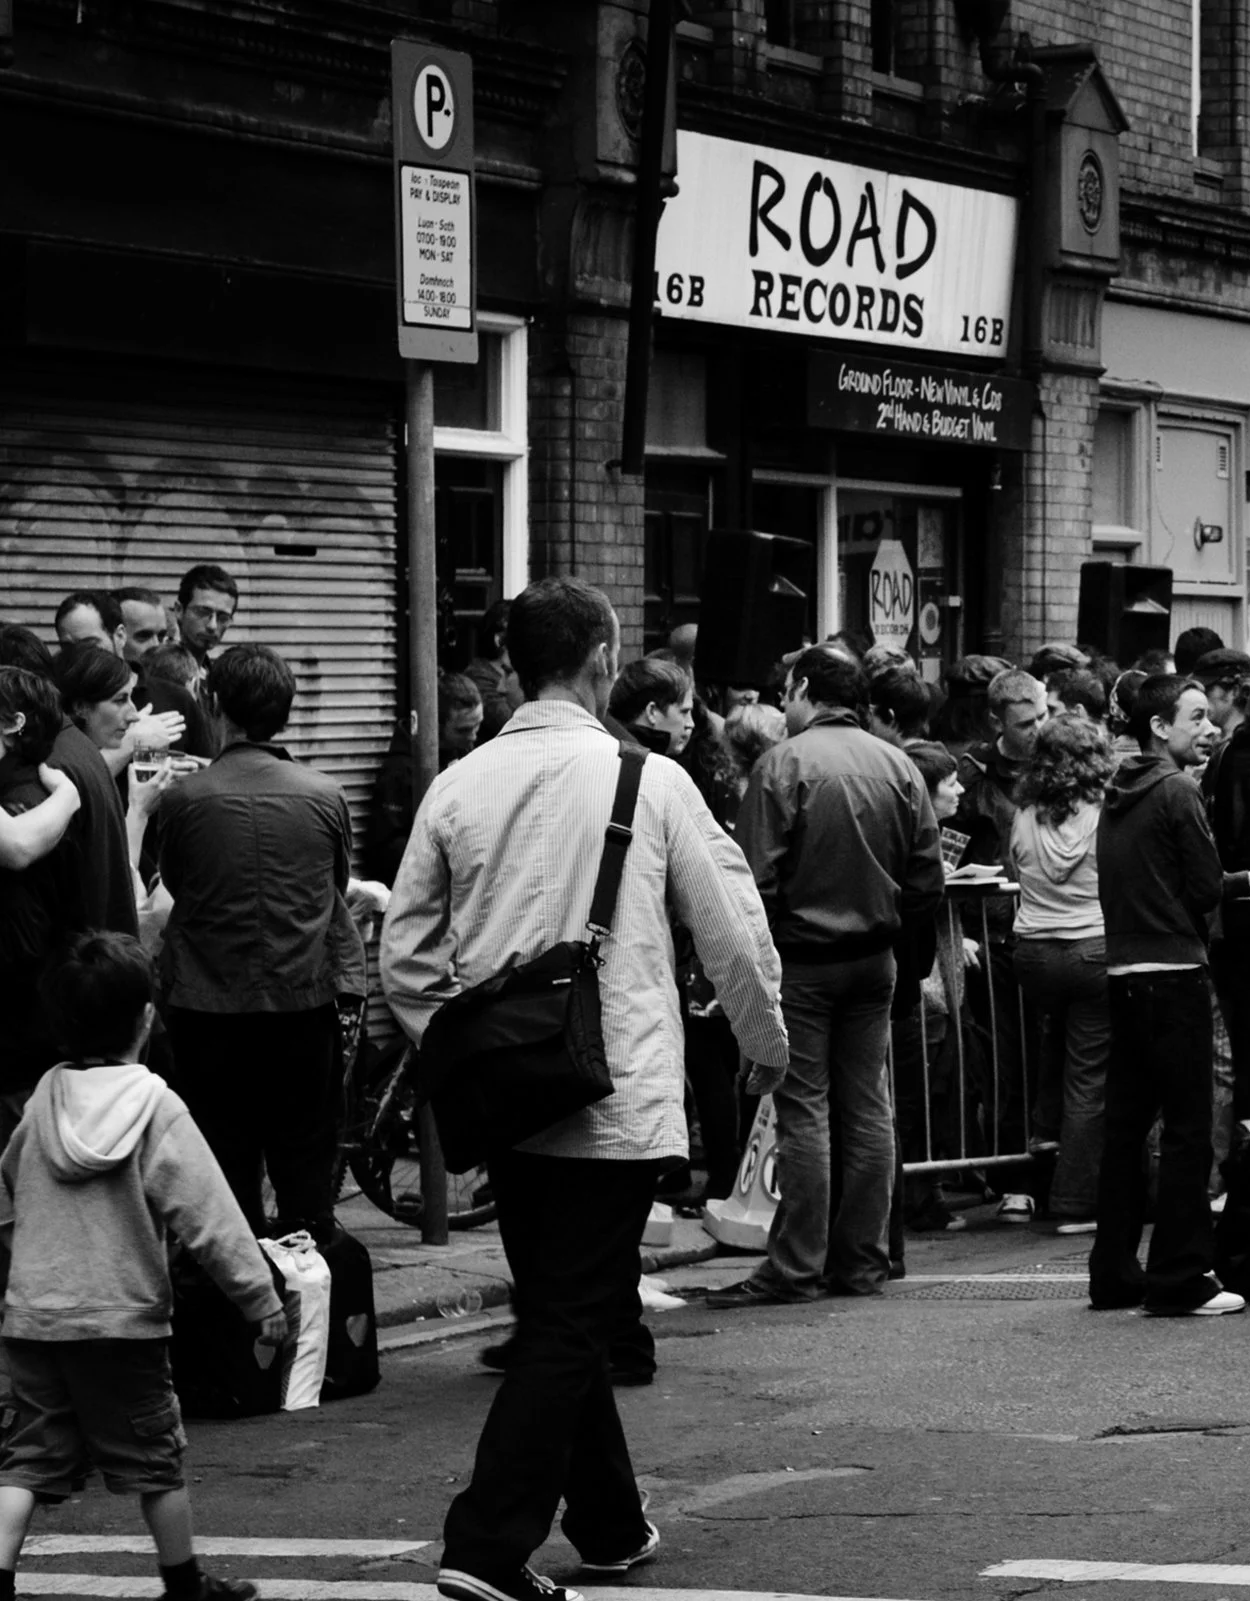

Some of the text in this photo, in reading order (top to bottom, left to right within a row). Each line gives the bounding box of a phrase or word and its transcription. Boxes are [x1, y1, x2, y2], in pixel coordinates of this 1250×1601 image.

[425, 74, 446, 137] P
[410, 187, 423, 199] PAY
[432, 189, 461, 206] DISPLAY
[749, 160, 937, 280] ROAD
[419, 248, 436, 261] MON
[441, 251, 454, 263] SAT
[424, 305, 451, 319] SUNDAY
[749, 269, 925, 338] RECORDS
[960, 315, 1004, 346] 16B
[876, 399, 894, 429] 2nd
[871, 569, 912, 622] ROAD
